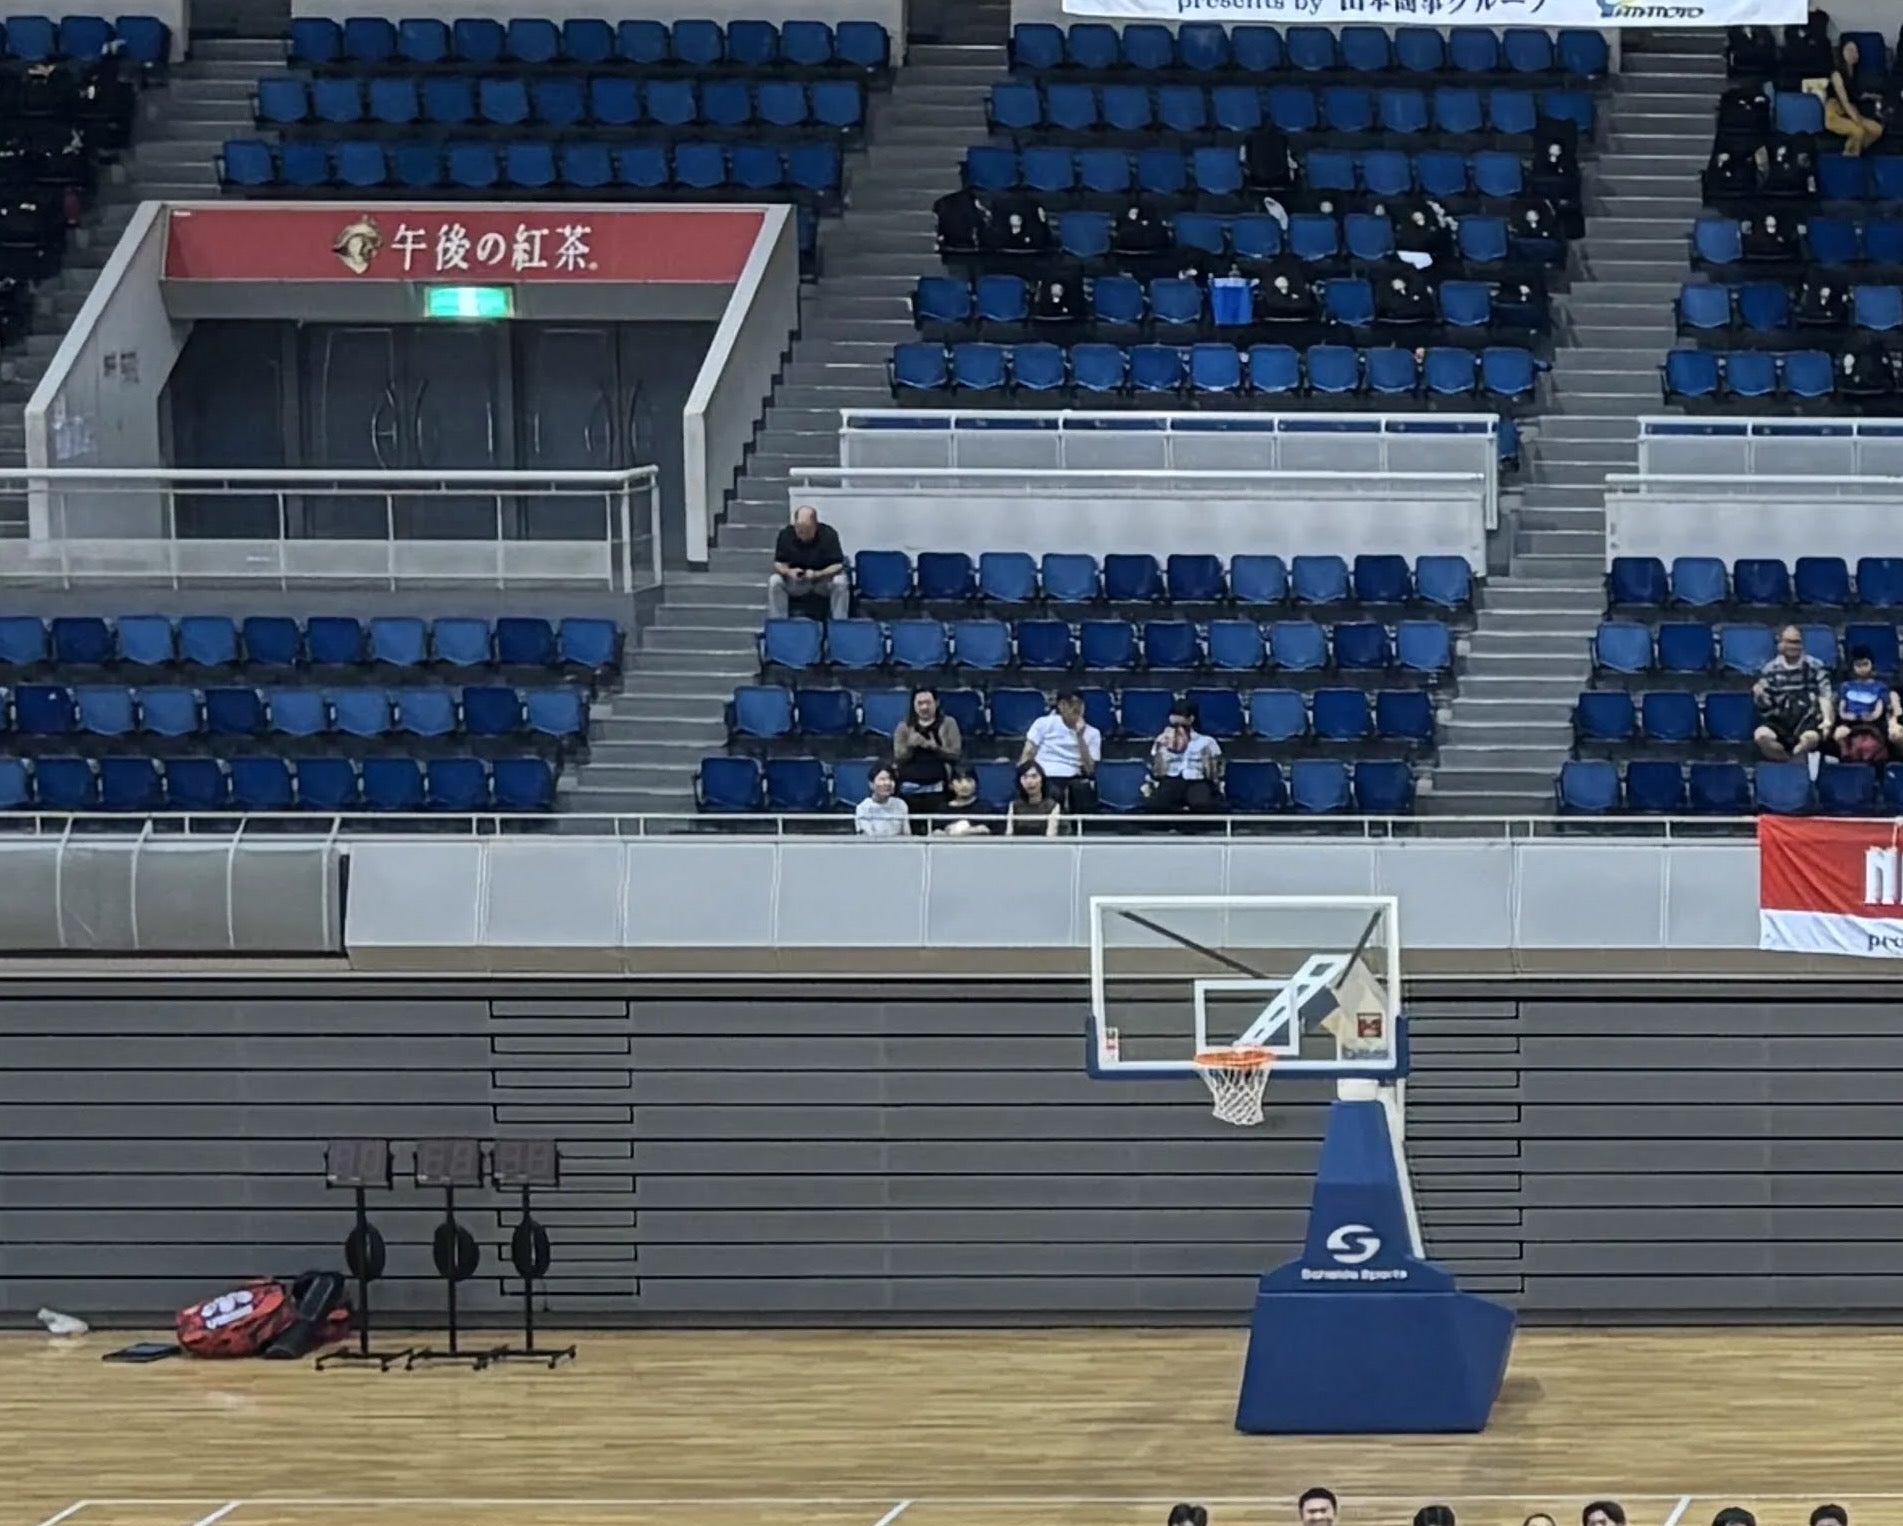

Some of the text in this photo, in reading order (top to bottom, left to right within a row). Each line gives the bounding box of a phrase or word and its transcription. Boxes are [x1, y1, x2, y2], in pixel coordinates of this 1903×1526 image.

[391, 223, 592, 271] 午後の紅茶
